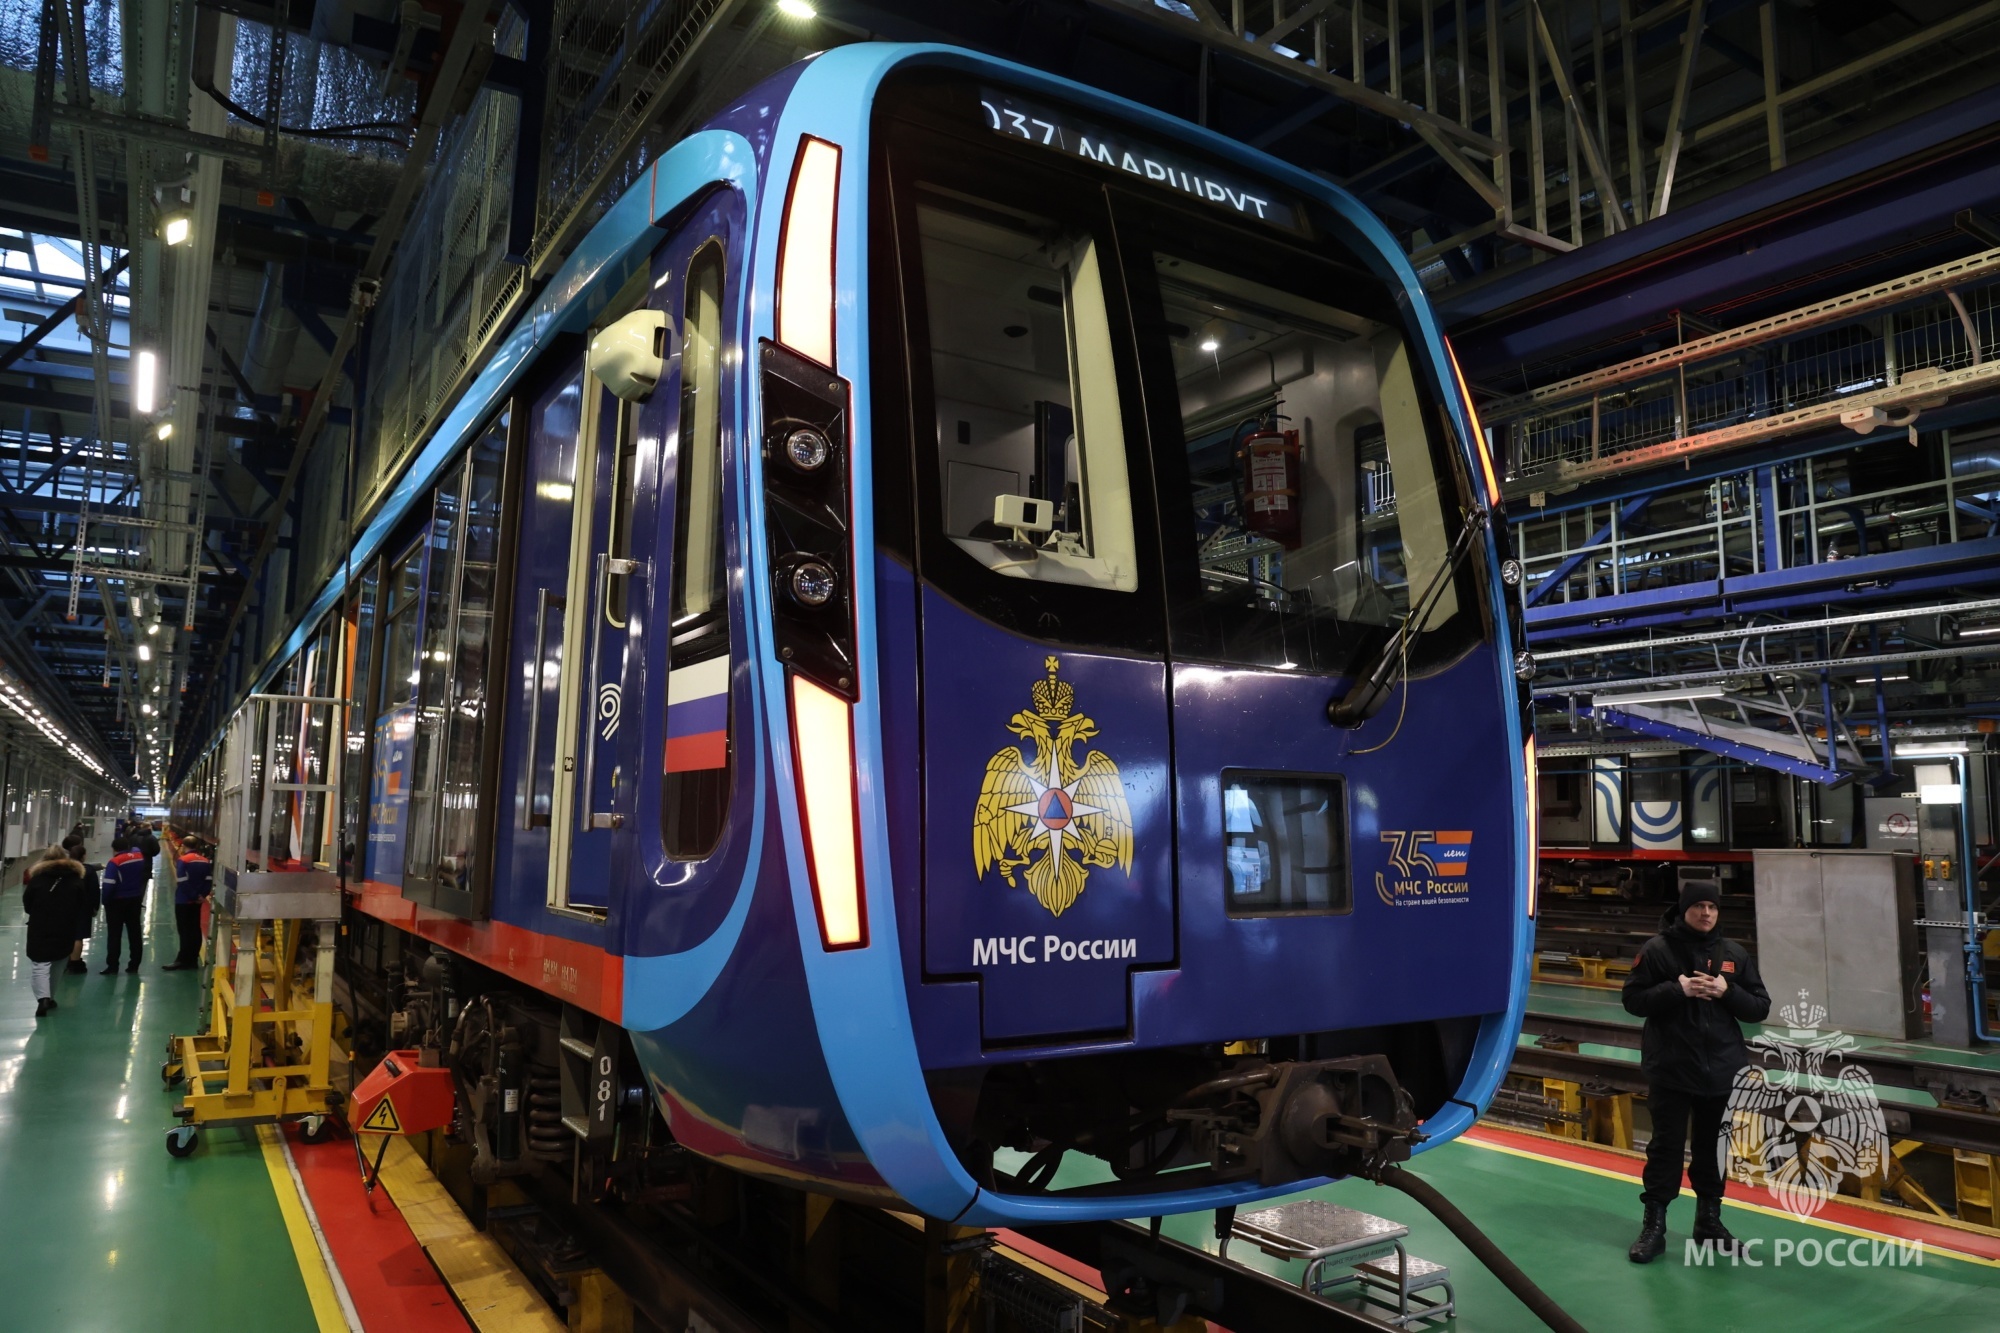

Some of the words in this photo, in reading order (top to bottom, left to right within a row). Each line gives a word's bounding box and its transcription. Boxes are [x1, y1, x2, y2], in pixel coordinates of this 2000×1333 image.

[1380, 830, 1437, 878] 35
[1443, 849, 1467, 858] лет
[1394, 880, 1422, 896] МЧС
[1427, 880, 1469, 895] России
[1395, 899, 1402, 907] На
[1403, 899, 1420, 907] страже
[1421, 897, 1437, 906] вашей
[1438, 896, 1469, 905] безопасности
[972, 935, 1037, 966] МЧС
[1043, 935, 1137, 962] России
[597, 1055, 612, 1121] 081
